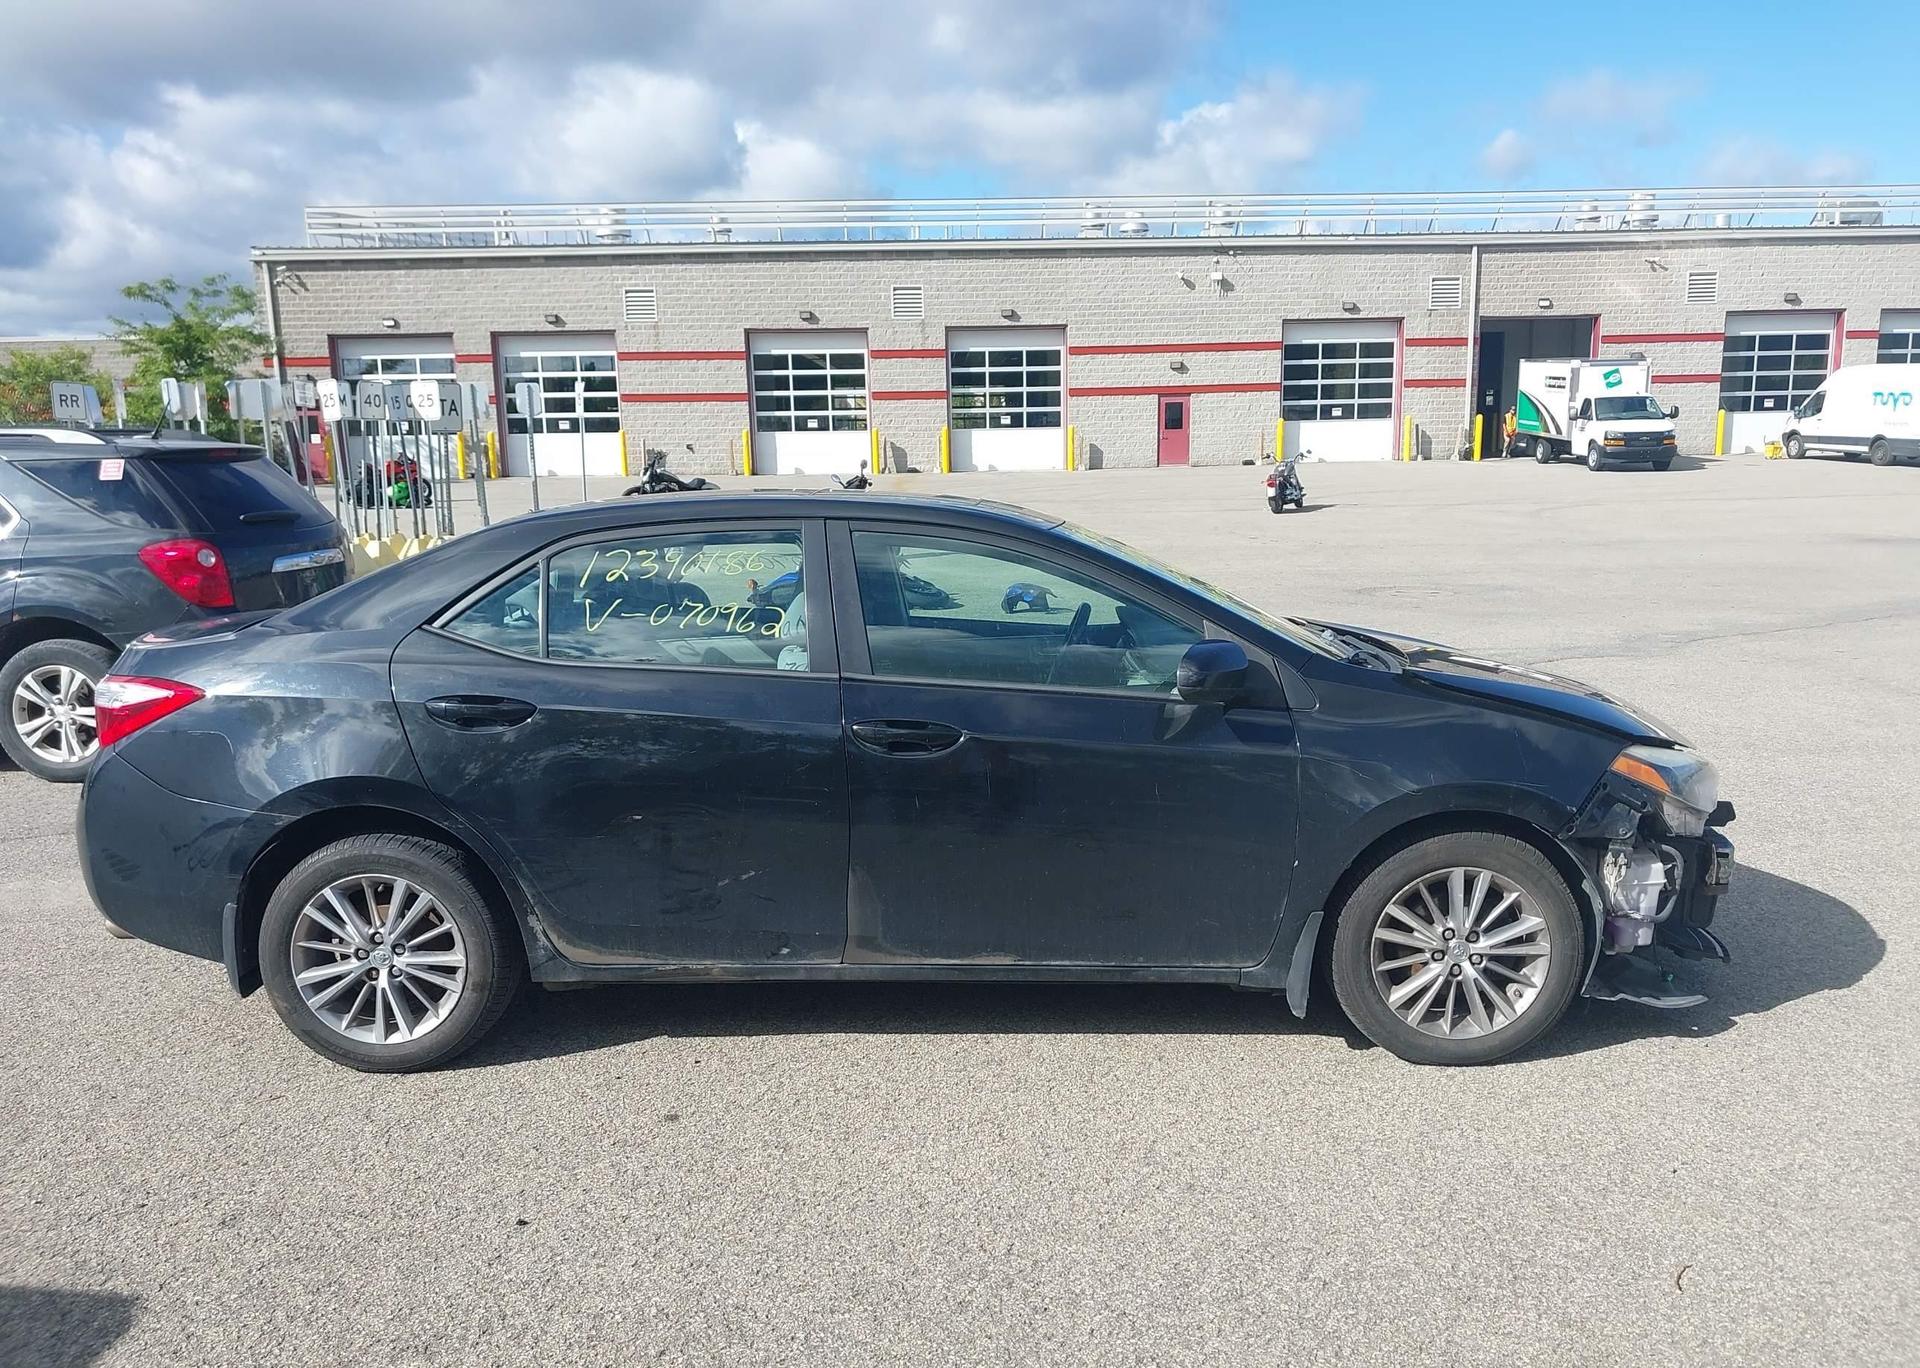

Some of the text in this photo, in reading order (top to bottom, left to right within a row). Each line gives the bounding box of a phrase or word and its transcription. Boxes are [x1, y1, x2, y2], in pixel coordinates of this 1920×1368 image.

[59, 394, 80, 408] RR
[322, 393, 336, 408] 25
[363, 394, 382, 408] 40
[390, 395, 401, 410] 15
[417, 394, 434, 408] 25
